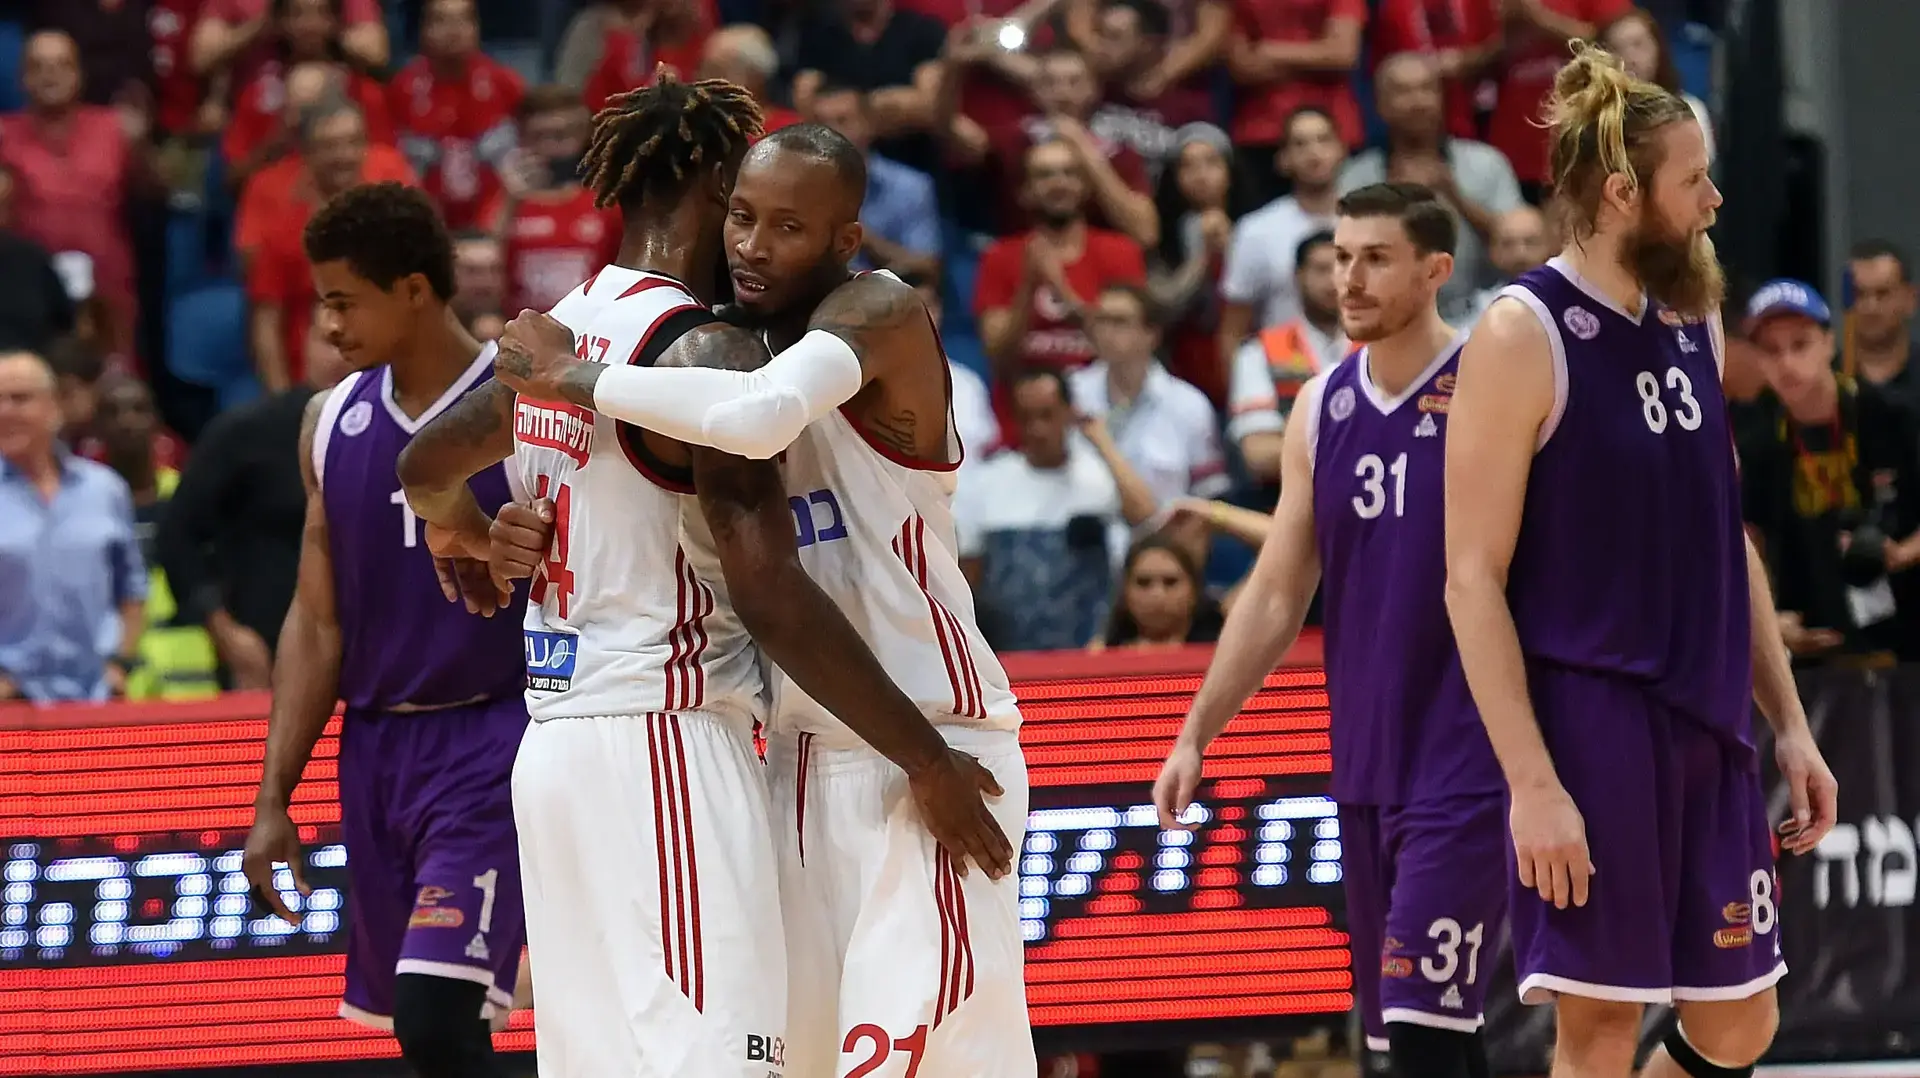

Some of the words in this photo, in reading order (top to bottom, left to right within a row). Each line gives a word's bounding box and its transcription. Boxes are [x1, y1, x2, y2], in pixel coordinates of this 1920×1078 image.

[1636, 366, 1702, 434] 83
[1352, 452, 1408, 519] 31
[1813, 813, 1920, 911] מה
[472, 868, 499, 933] 1
[1750, 868, 1779, 935] 8
[1420, 916, 1484, 985] 31
[842, 1023, 928, 1078] 21
